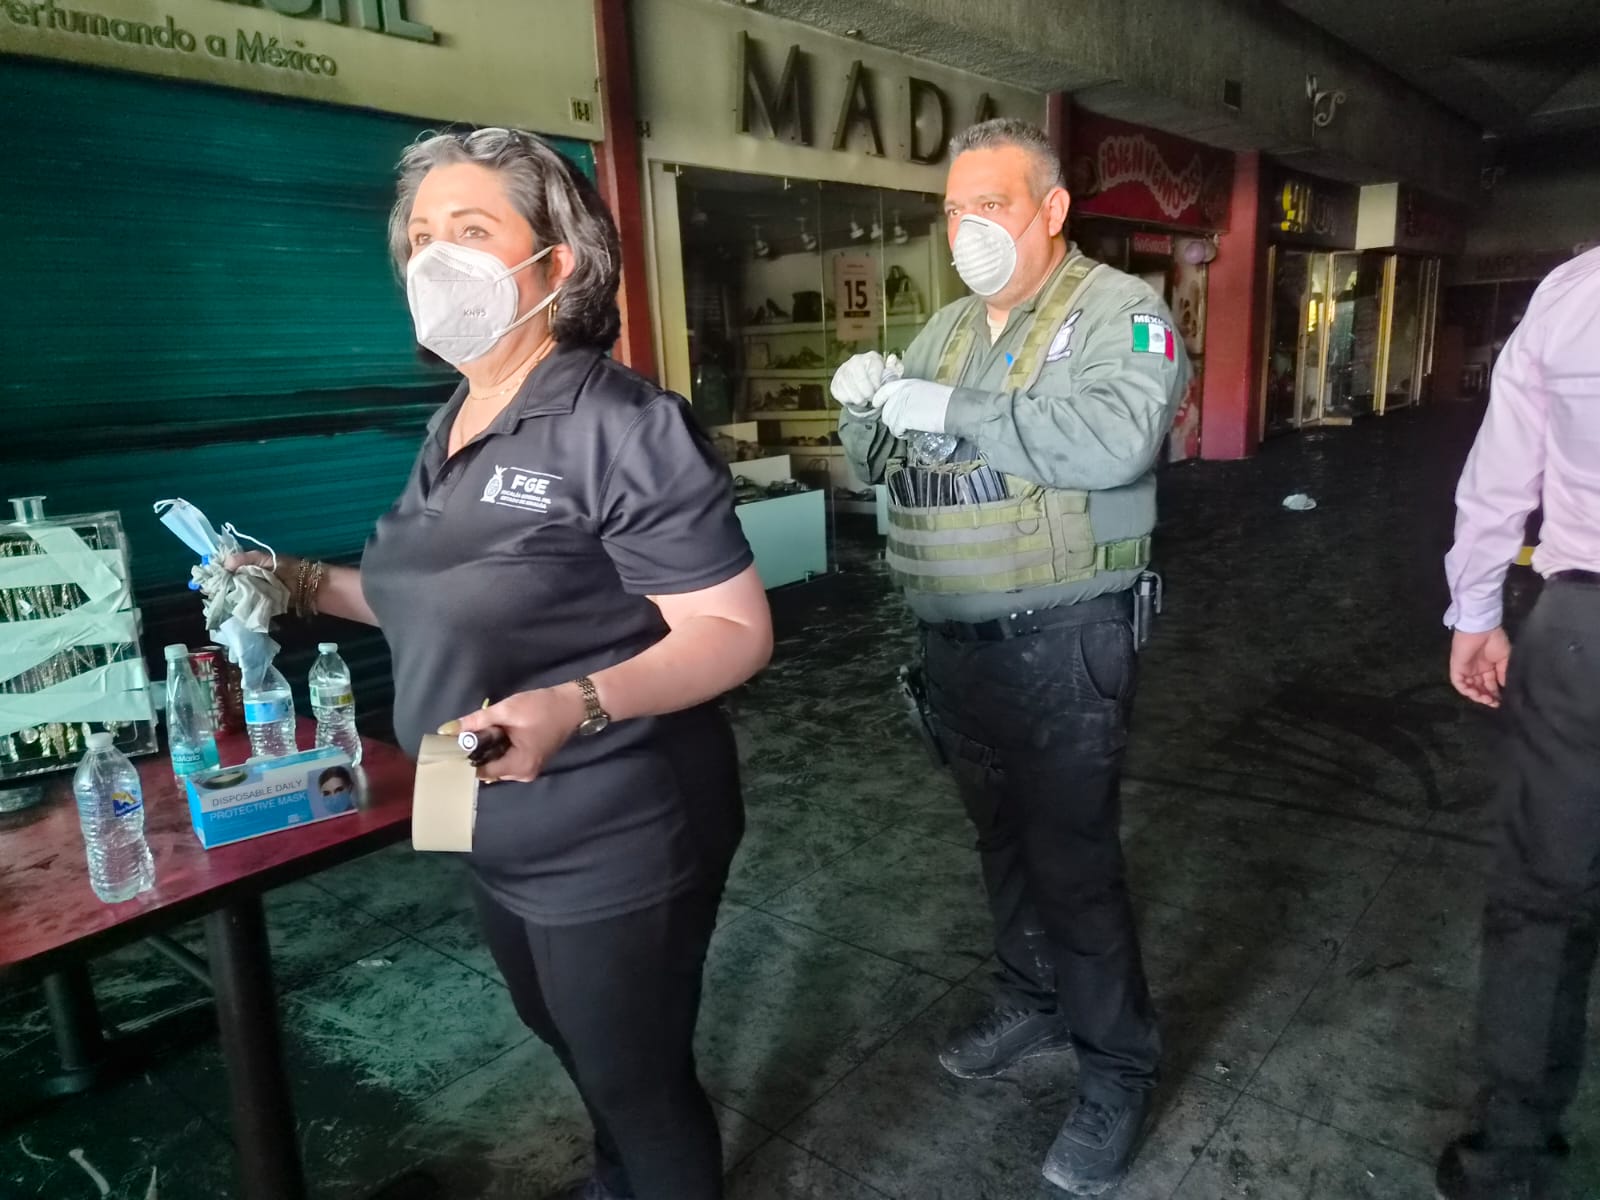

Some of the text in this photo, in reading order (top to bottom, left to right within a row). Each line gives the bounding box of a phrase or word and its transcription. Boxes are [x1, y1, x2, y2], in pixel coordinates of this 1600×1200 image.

[0, 0, 338, 77] erfumando a México
[844, 280, 868, 310] 15
[463, 308, 487, 318] KN95
[511, 474, 551, 495] FGE
[210, 801, 276, 822] PROTECTIVE
[278, 792, 307, 806] MASK
[212, 780, 303, 807] DISPOSABLE DAILY
